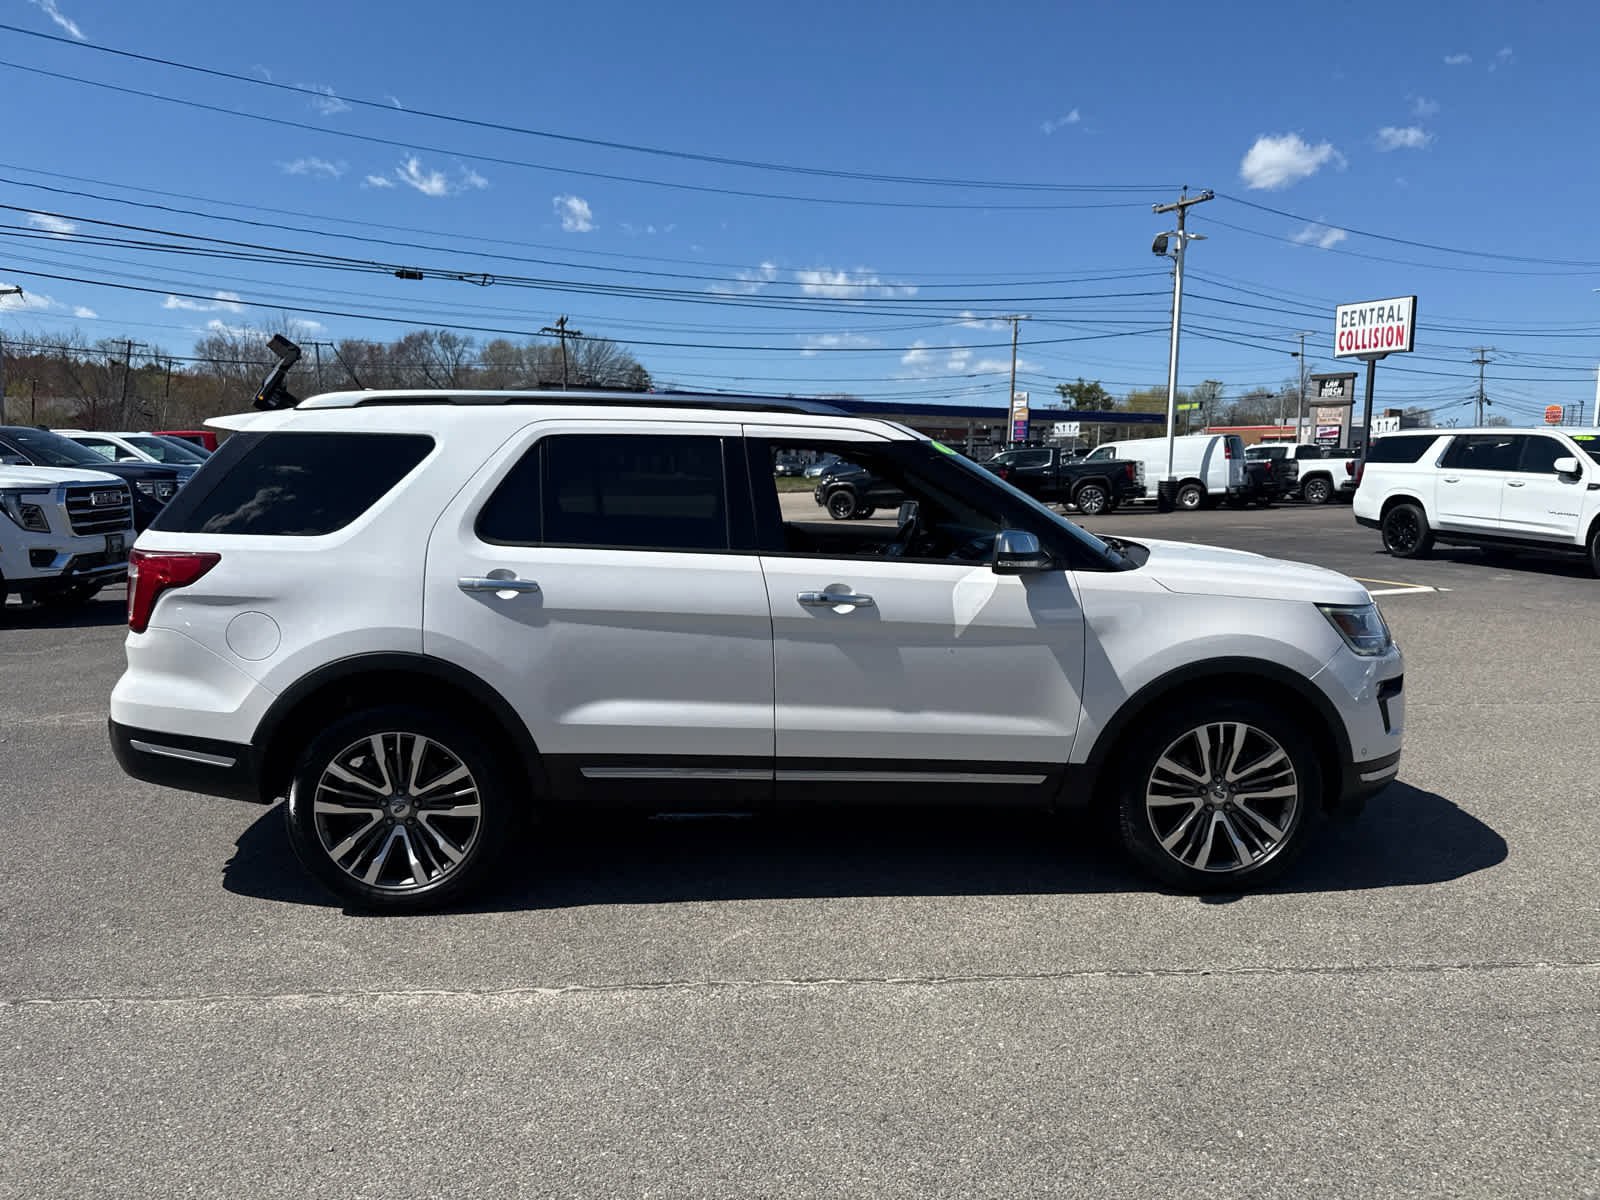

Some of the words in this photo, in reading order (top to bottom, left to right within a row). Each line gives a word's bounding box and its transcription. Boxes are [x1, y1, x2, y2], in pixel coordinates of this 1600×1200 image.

[1341, 304, 1404, 328] CENTRAL
[1338, 325, 1405, 351] COLLISION
[1321, 387, 1343, 397] WASH
